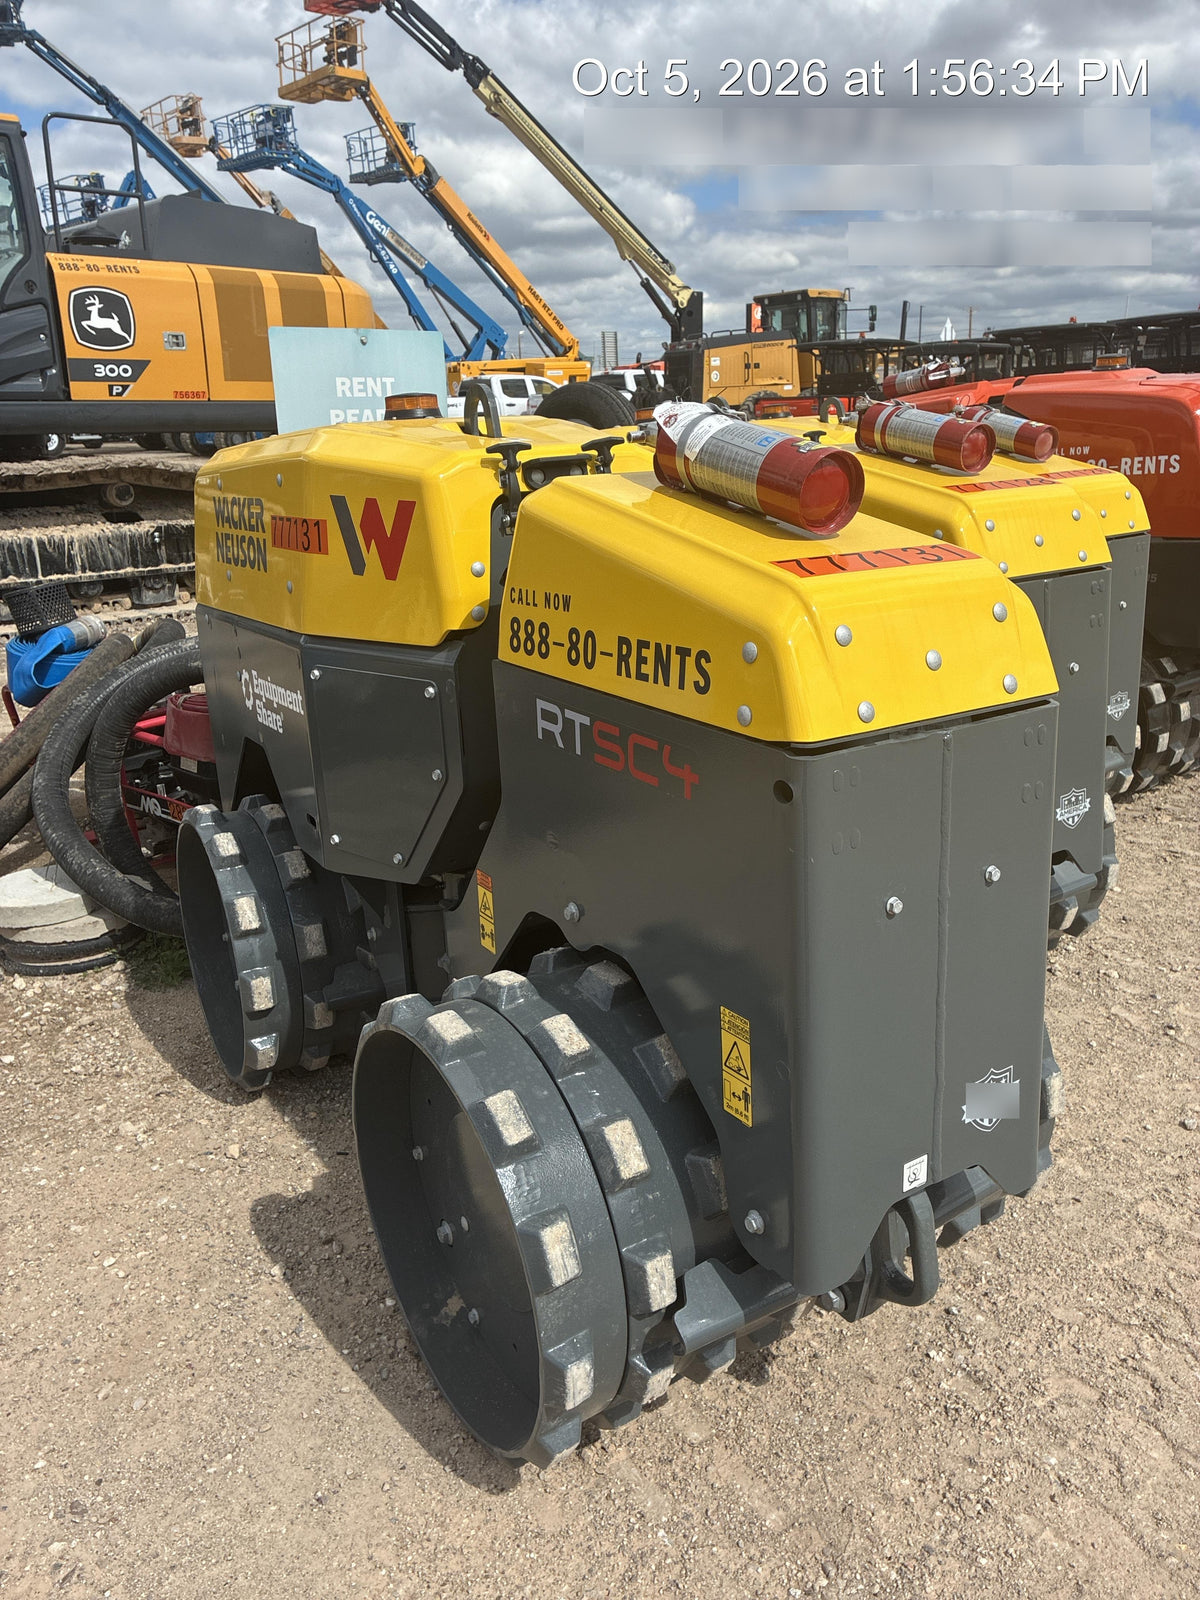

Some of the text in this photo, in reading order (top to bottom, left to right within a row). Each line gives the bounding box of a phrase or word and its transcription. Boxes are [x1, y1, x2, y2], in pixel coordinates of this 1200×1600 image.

[366, 211, 390, 237] Geni
[58, 262, 140, 274] 888-80-RENTS
[552, 315, 564, 331] PRO
[93, 364, 133, 378] 300
[112, 385, 123, 396] P
[173, 390, 206, 399] 756367
[335, 376, 396, 398] RENT
[1069, 445, 1091, 456] NOW
[213, 496, 266, 534] WACKER
[271, 515, 323, 553] 777131
[215, 531, 268, 573] NEUSON
[776, 544, 967, 576] 777131
[509, 586, 572, 613] CALL NOW
[509, 616, 712, 695] 888-80-RENTS
[251, 669, 304, 715] Equipment
[255, 699, 283, 734] Share
[140, 794, 162, 817] MQ
